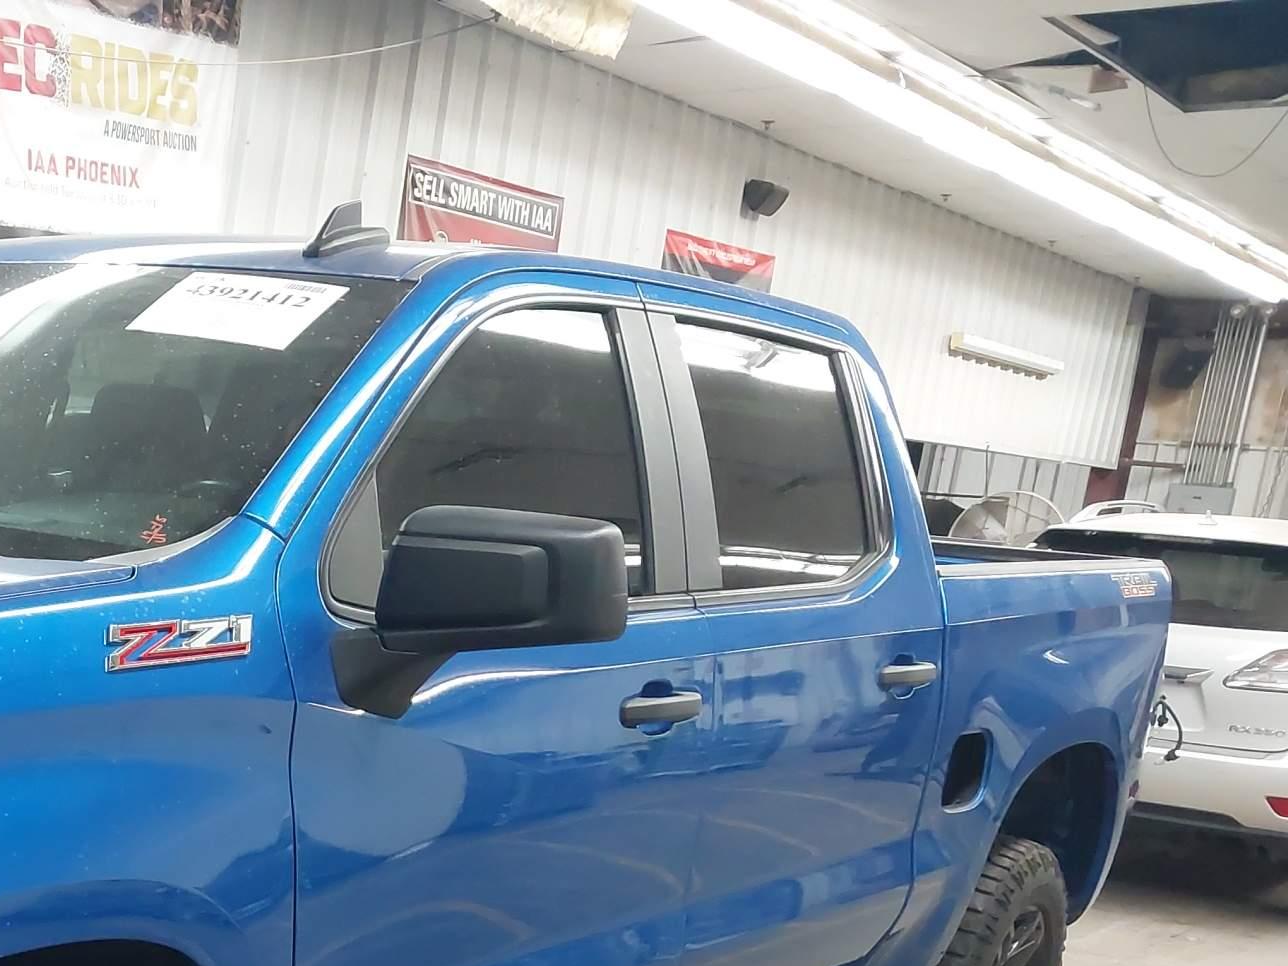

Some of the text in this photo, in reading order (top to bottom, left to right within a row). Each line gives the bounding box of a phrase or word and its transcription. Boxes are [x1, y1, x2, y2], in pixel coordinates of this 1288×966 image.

[69, 32, 200, 127] RIDES
[103, 119, 198, 153] A POWERSPORT AUCTION
[27, 148, 140, 190] IAA PHOENIX
[414, 172, 552, 233] SELL SMART WITH IAA
[186, 284, 312, 308] 43921412
[103, 613, 254, 673] Z71
